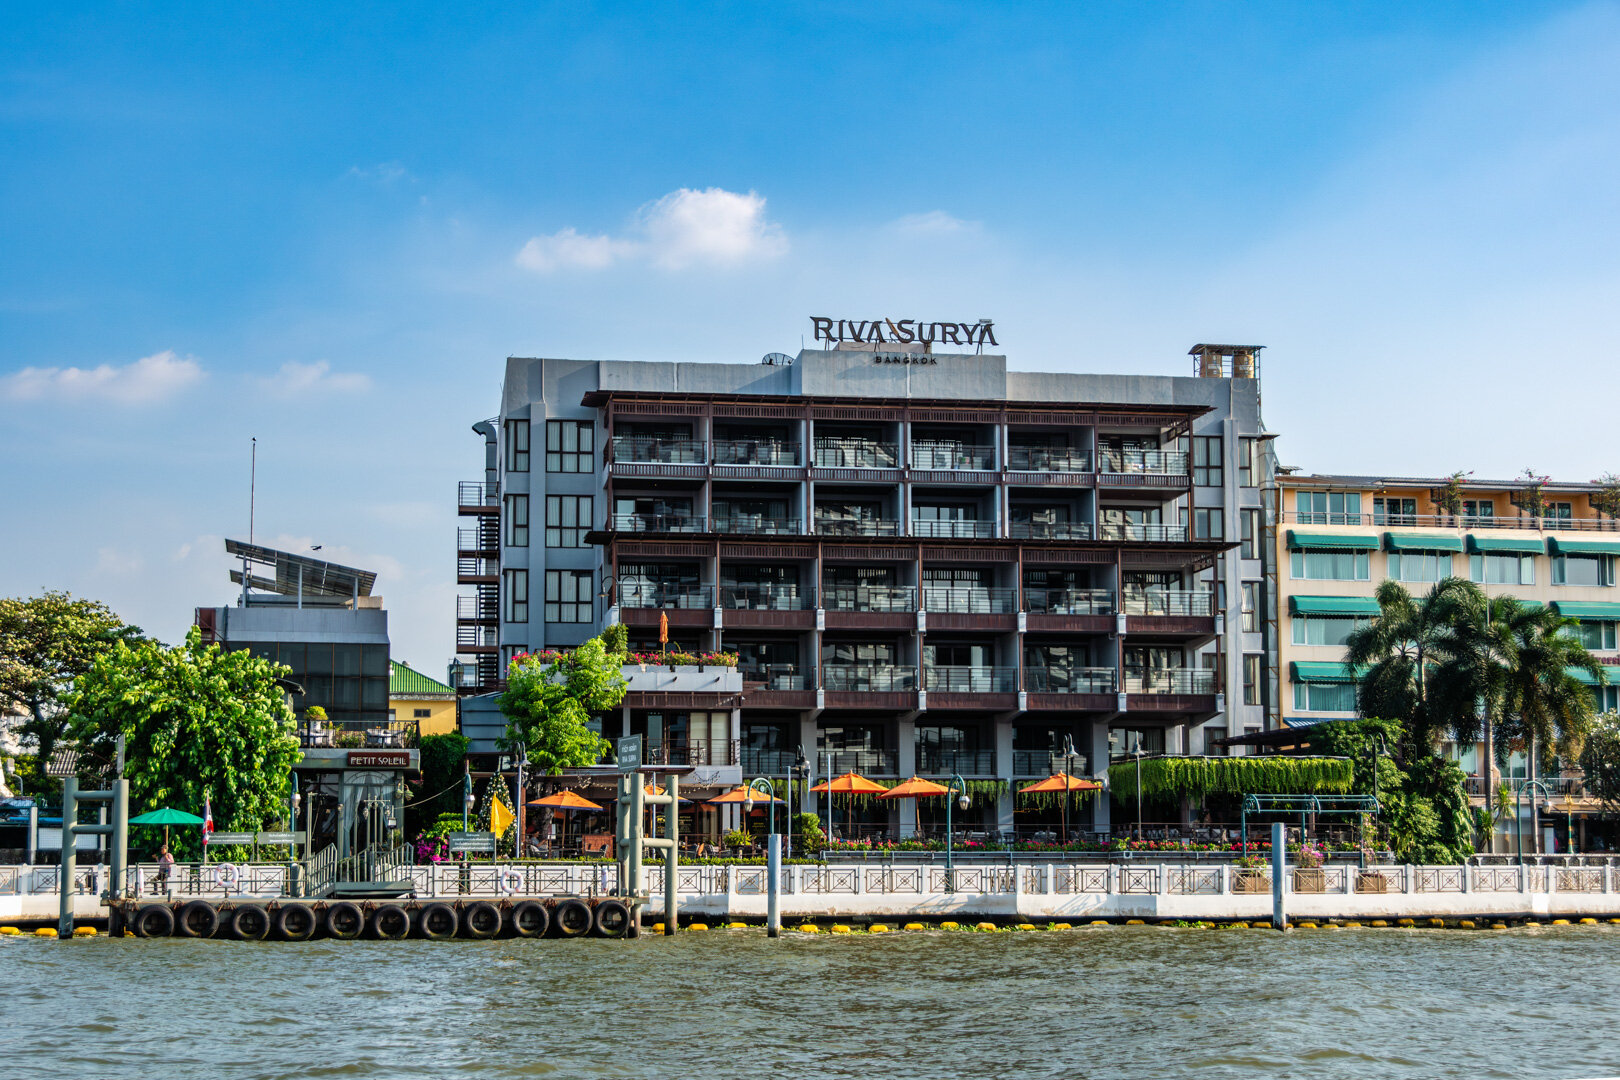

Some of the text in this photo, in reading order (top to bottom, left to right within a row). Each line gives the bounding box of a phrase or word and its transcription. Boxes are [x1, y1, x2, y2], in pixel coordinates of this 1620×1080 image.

[810, 316, 999, 346] RIVA SURYA
[874, 356, 937, 365] BANGKOK
[350, 756, 407, 765] PETIT SOLEIL
